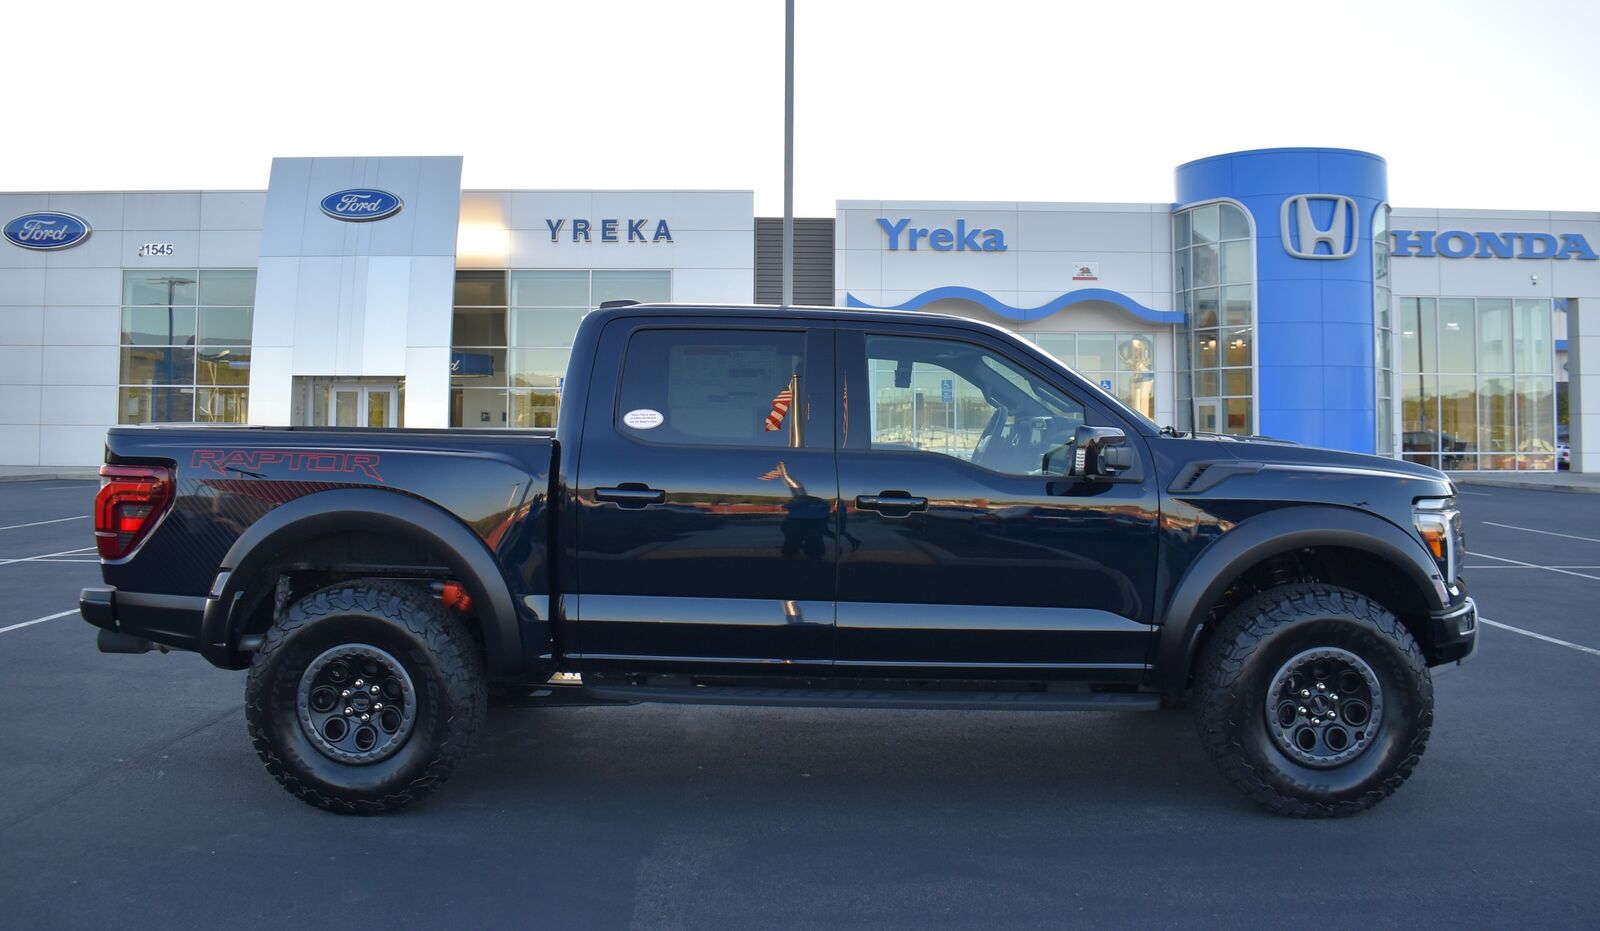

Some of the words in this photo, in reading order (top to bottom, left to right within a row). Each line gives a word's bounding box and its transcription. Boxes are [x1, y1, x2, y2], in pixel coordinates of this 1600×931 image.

[336, 194, 382, 212] Ford
[19, 219, 68, 241] Ford
[545, 219, 674, 242] YREKA
[875, 218, 1009, 252] Yreka
[144, 244, 173, 255] 1545
[1390, 230, 1599, 260] HONDA
[191, 449, 385, 482] RAPTOR
